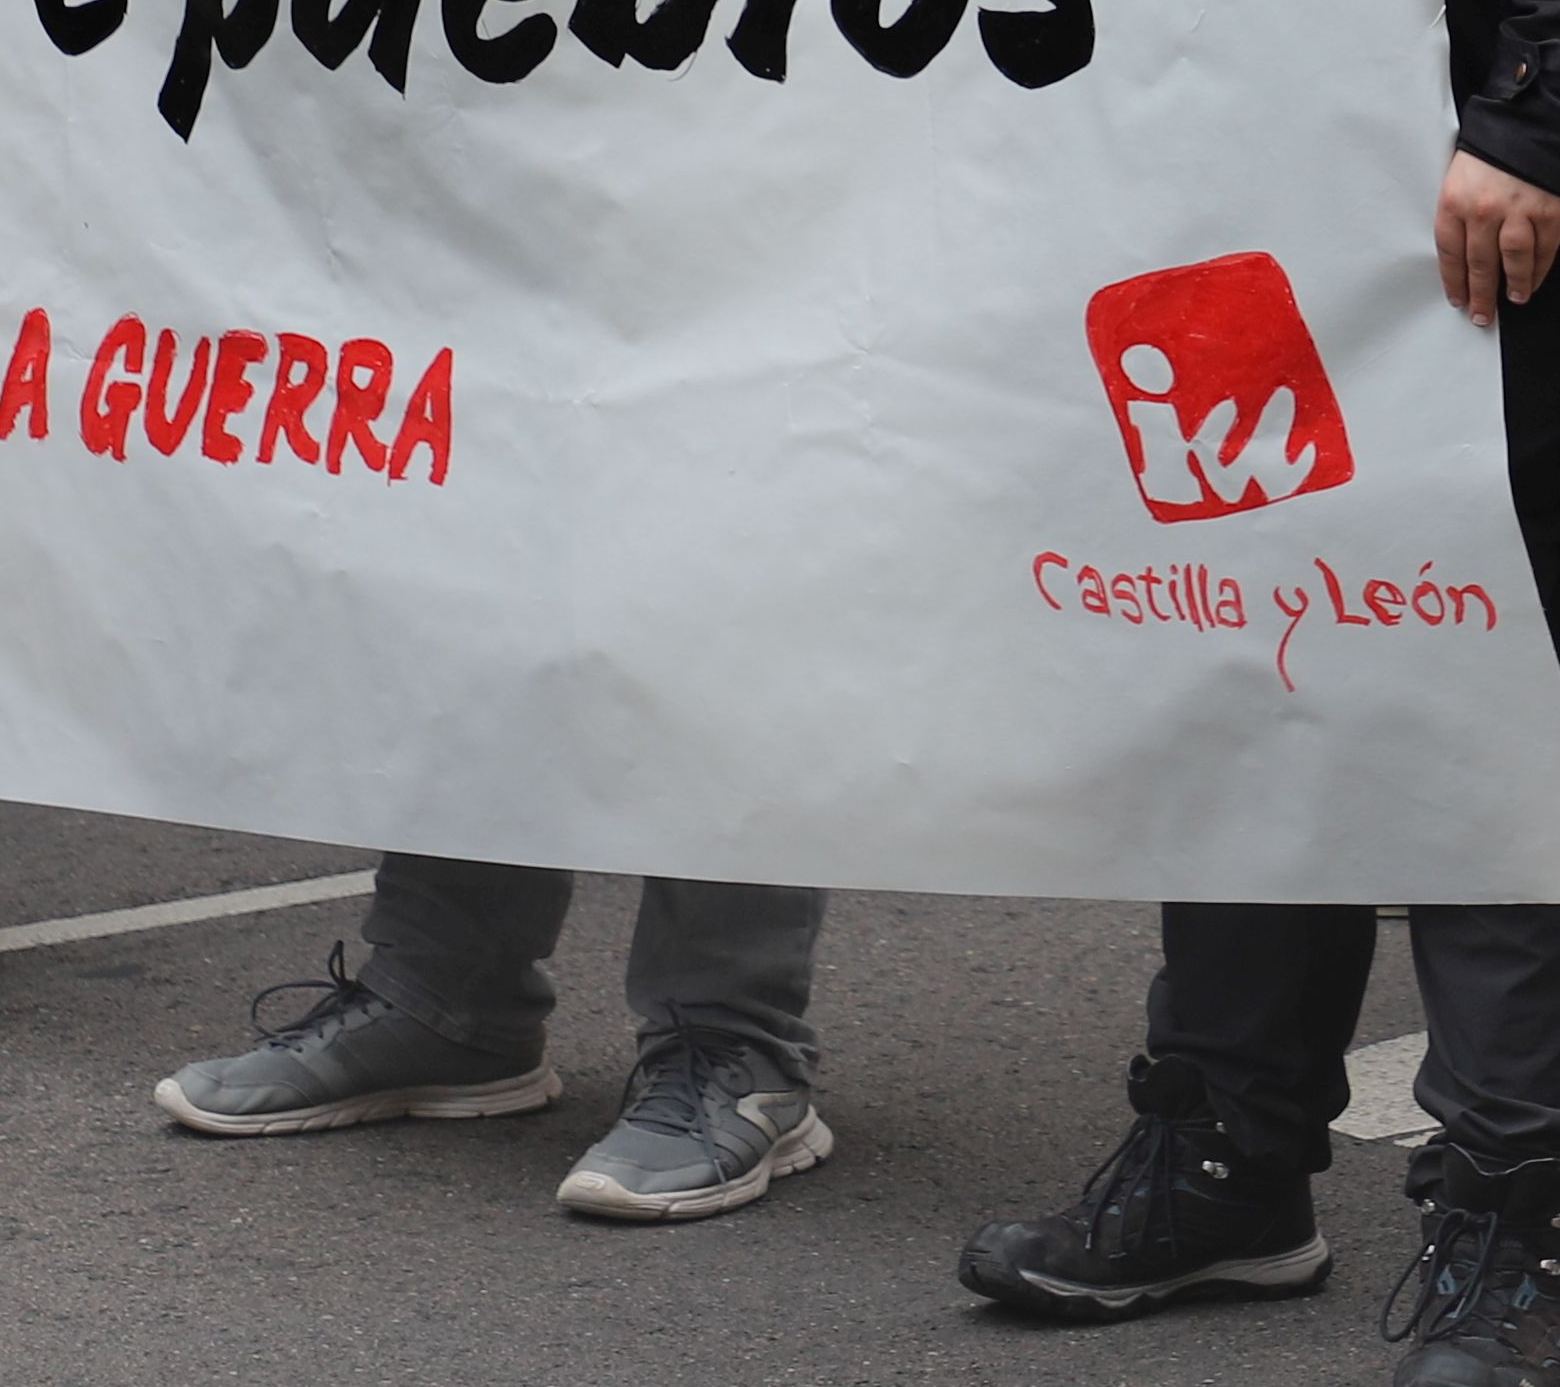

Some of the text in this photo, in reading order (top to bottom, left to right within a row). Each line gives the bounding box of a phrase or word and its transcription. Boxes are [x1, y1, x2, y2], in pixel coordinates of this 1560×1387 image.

[79, 313, 454, 487] GUERRA
[1032, 550, 1498, 693] Castilla y León
